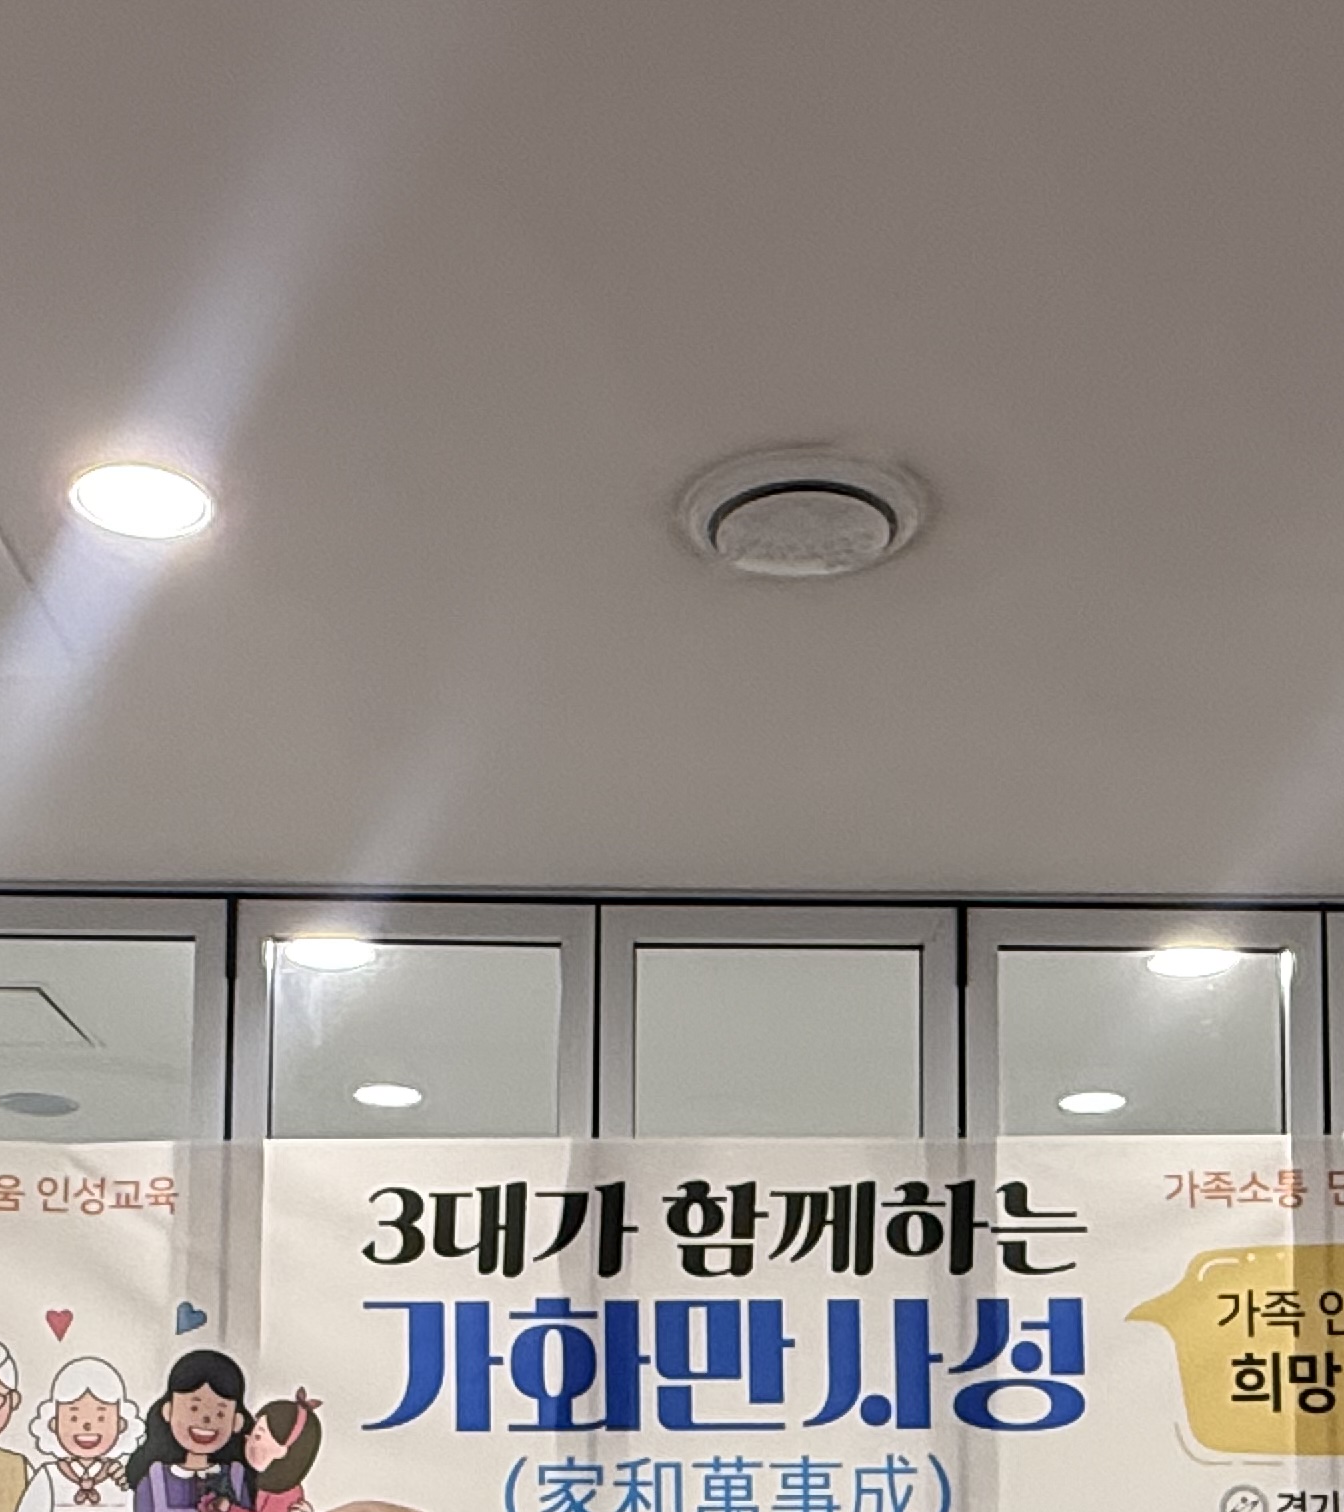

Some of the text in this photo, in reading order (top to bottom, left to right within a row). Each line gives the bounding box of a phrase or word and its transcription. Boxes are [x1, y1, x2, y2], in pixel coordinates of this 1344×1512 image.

[37, 1175, 179, 1215] 인성교육
[1164, 1170, 1309, 1208] 가족소통
[361, 1180, 1088, 1278] 3대가 함께하는
[1216, 1289, 1306, 1338] 가족
[361, 1296, 1087, 1432] 가화만사성
[1230, 1352, 1342, 1414] 희망
